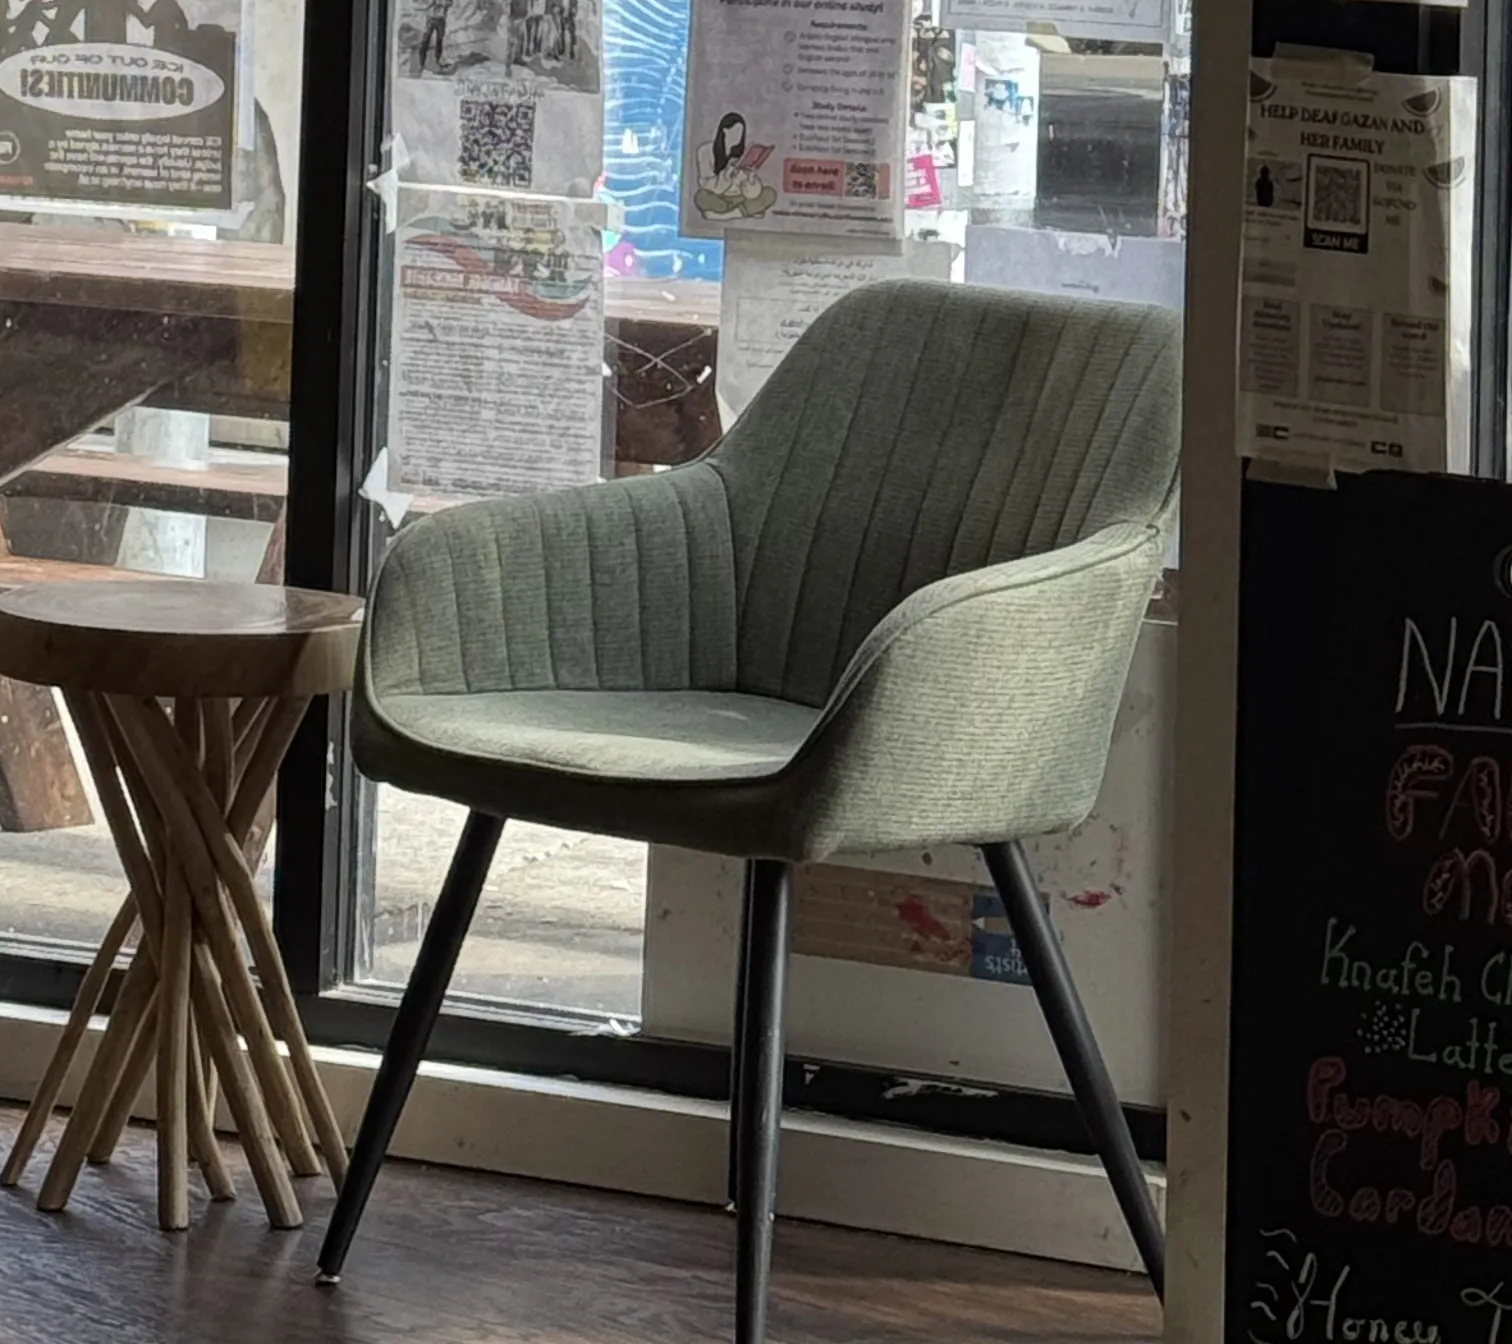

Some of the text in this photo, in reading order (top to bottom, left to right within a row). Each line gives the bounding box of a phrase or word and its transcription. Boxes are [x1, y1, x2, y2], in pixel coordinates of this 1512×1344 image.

[1260, 103, 1425, 135] HELP DEAF GAZAN AND
[1300, 131, 1385, 154] HER FAMILY
[1374, 164, 1416, 177] DONATE
[1310, 233, 1361, 251] SCAN ME
[1320, 916, 1463, 1003] Knafeh
[1307, 1055, 1512, 1171] Pumpk
